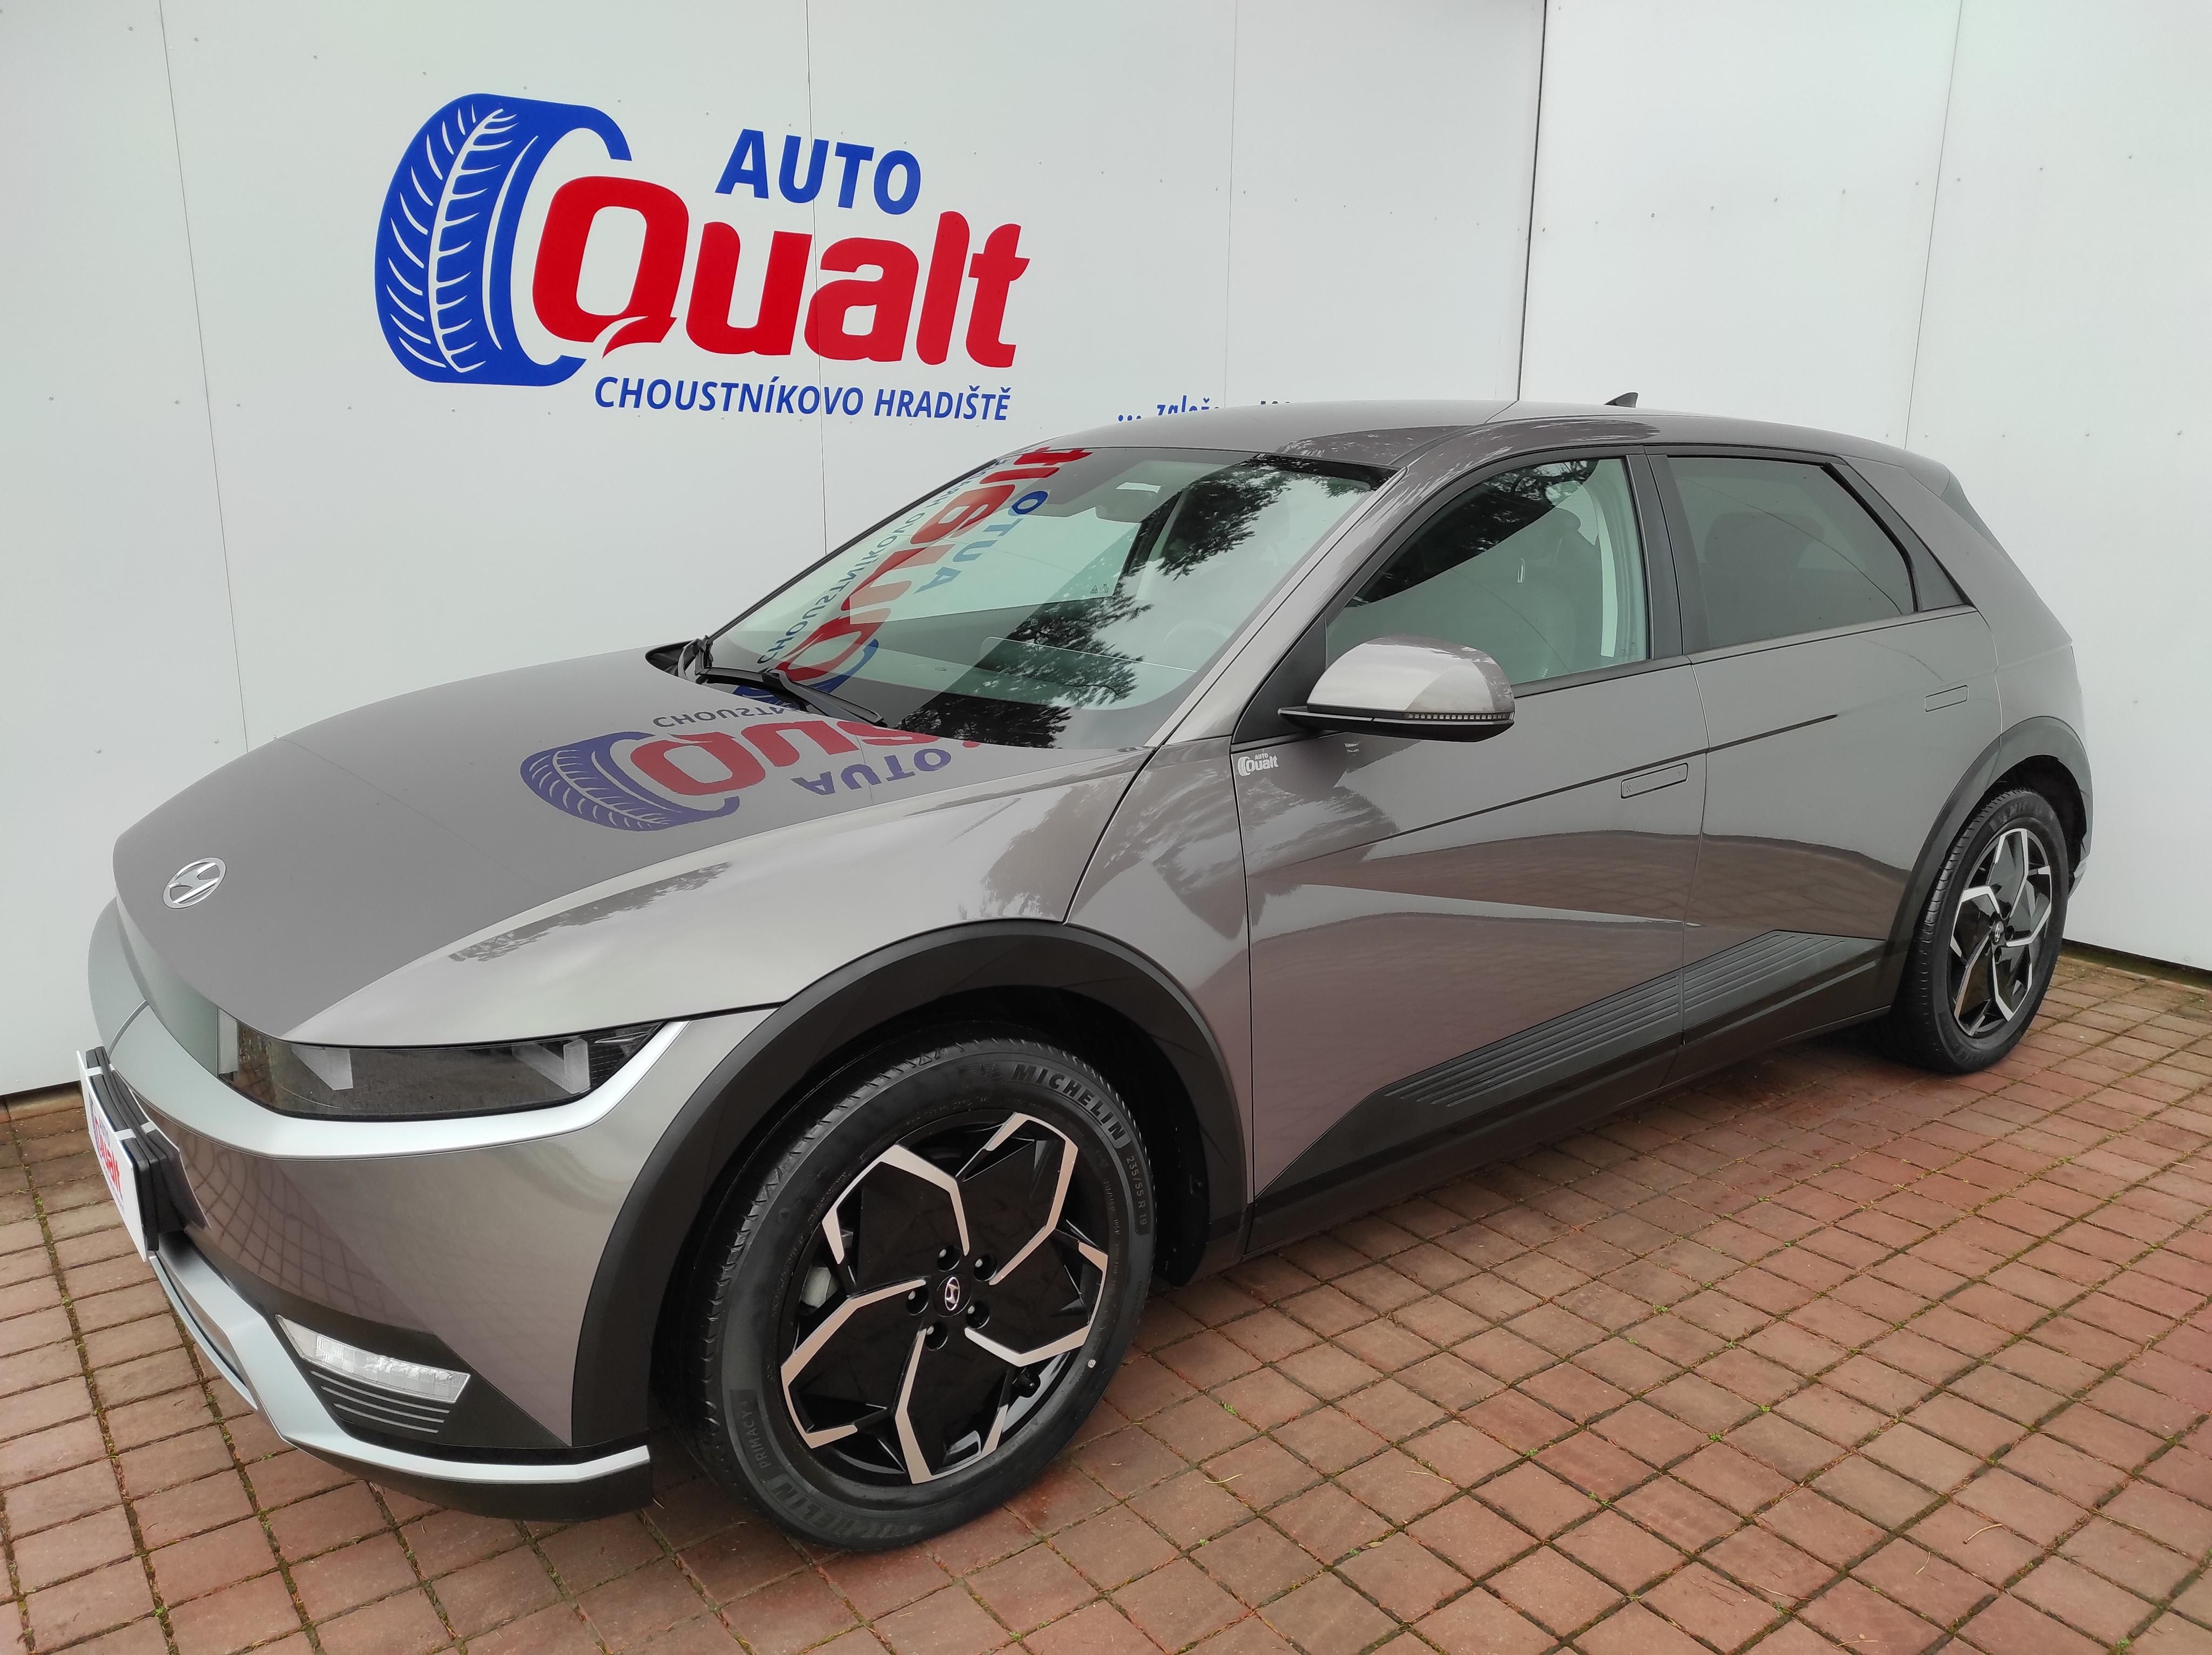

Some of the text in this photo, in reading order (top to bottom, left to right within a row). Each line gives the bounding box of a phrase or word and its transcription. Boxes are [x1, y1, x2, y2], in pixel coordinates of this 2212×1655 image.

[715, 129, 921, 215] AUTO
[532, 175, 1030, 368] Qualt
[594, 375, 1012, 422] CHOUSTNÍKOVO HRADIŠTĚ
[1246, 755, 1279, 772] Qualt
[1010, 1064, 1127, 1141] MICHELIN
[1126, 1155, 1148, 1225] 235/55 R 19
[741, 1410, 772, 1469] PRIMACY
